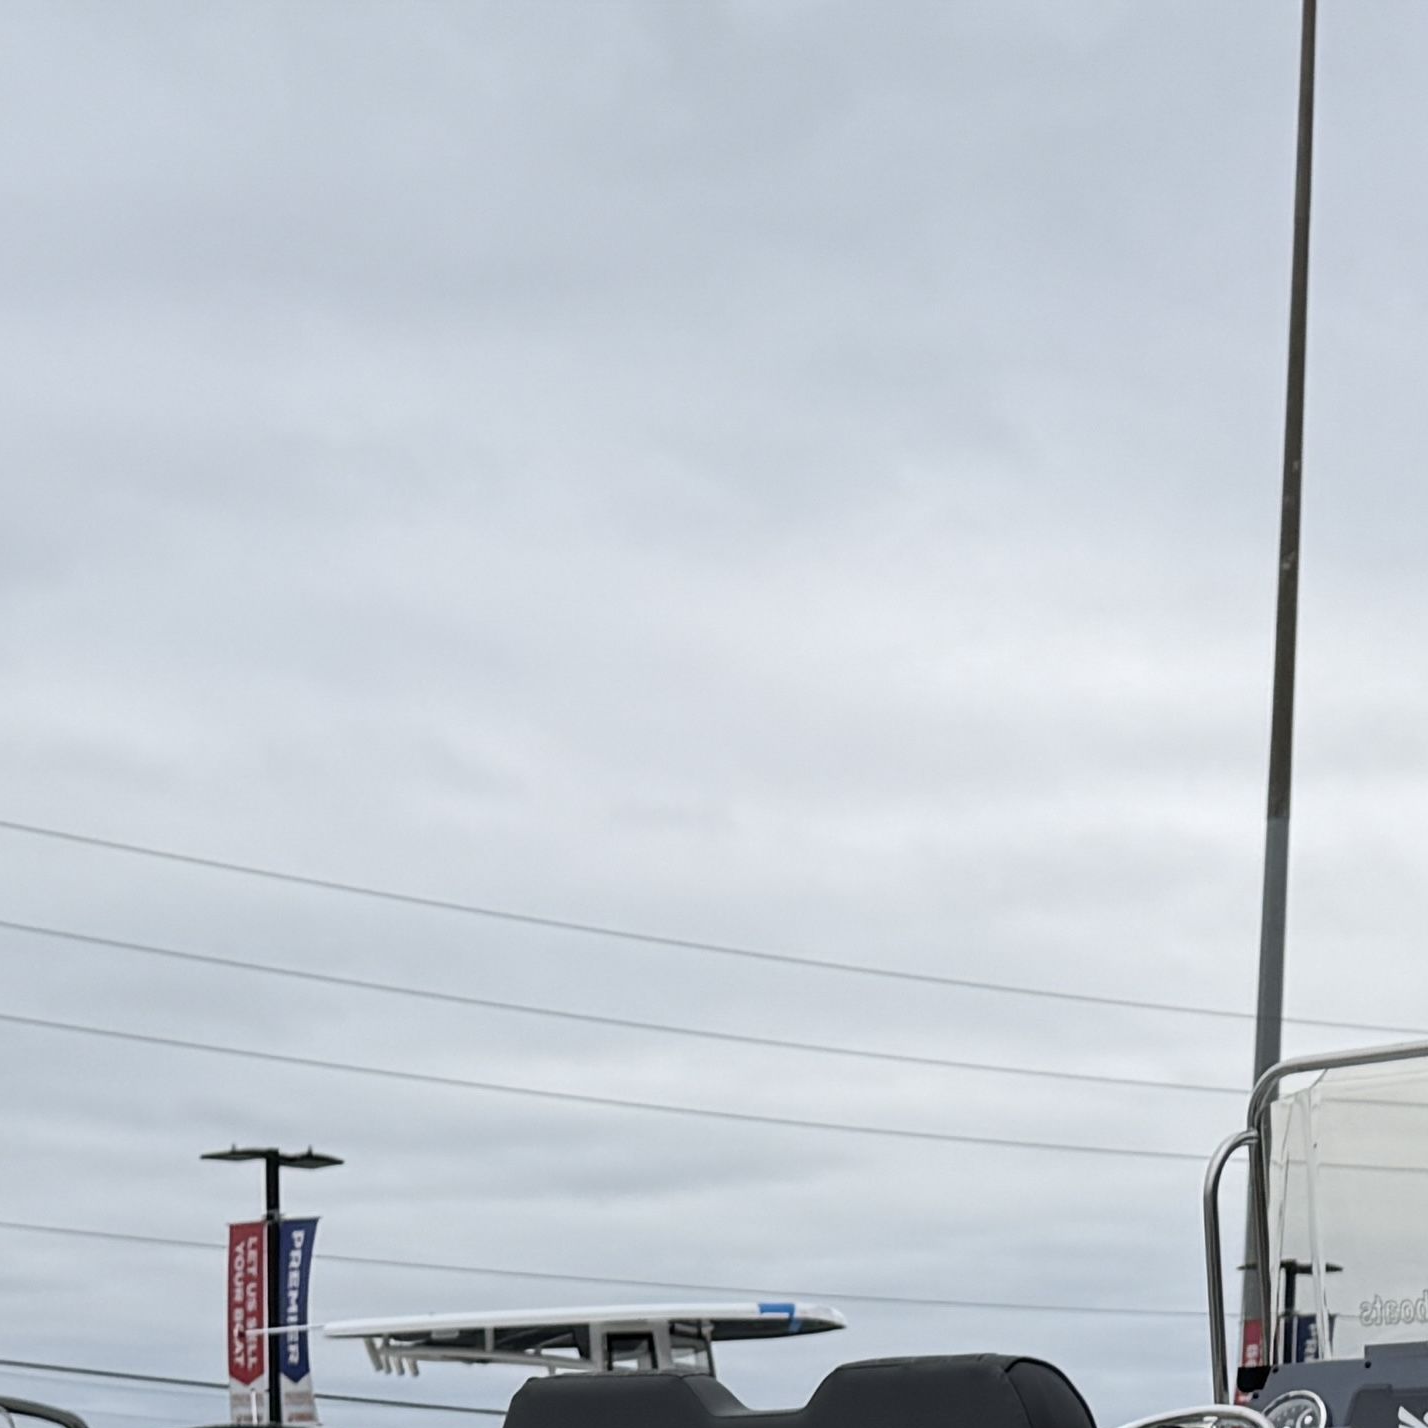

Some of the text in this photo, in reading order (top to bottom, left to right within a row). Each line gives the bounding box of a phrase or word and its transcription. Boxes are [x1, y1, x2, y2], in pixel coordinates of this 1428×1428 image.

[232, 1240, 245, 1303] YOUR
[246, 1235, 258, 1276] LET
[245, 1282, 257, 1312] US
[286, 1229, 305, 1366] PREMIER
